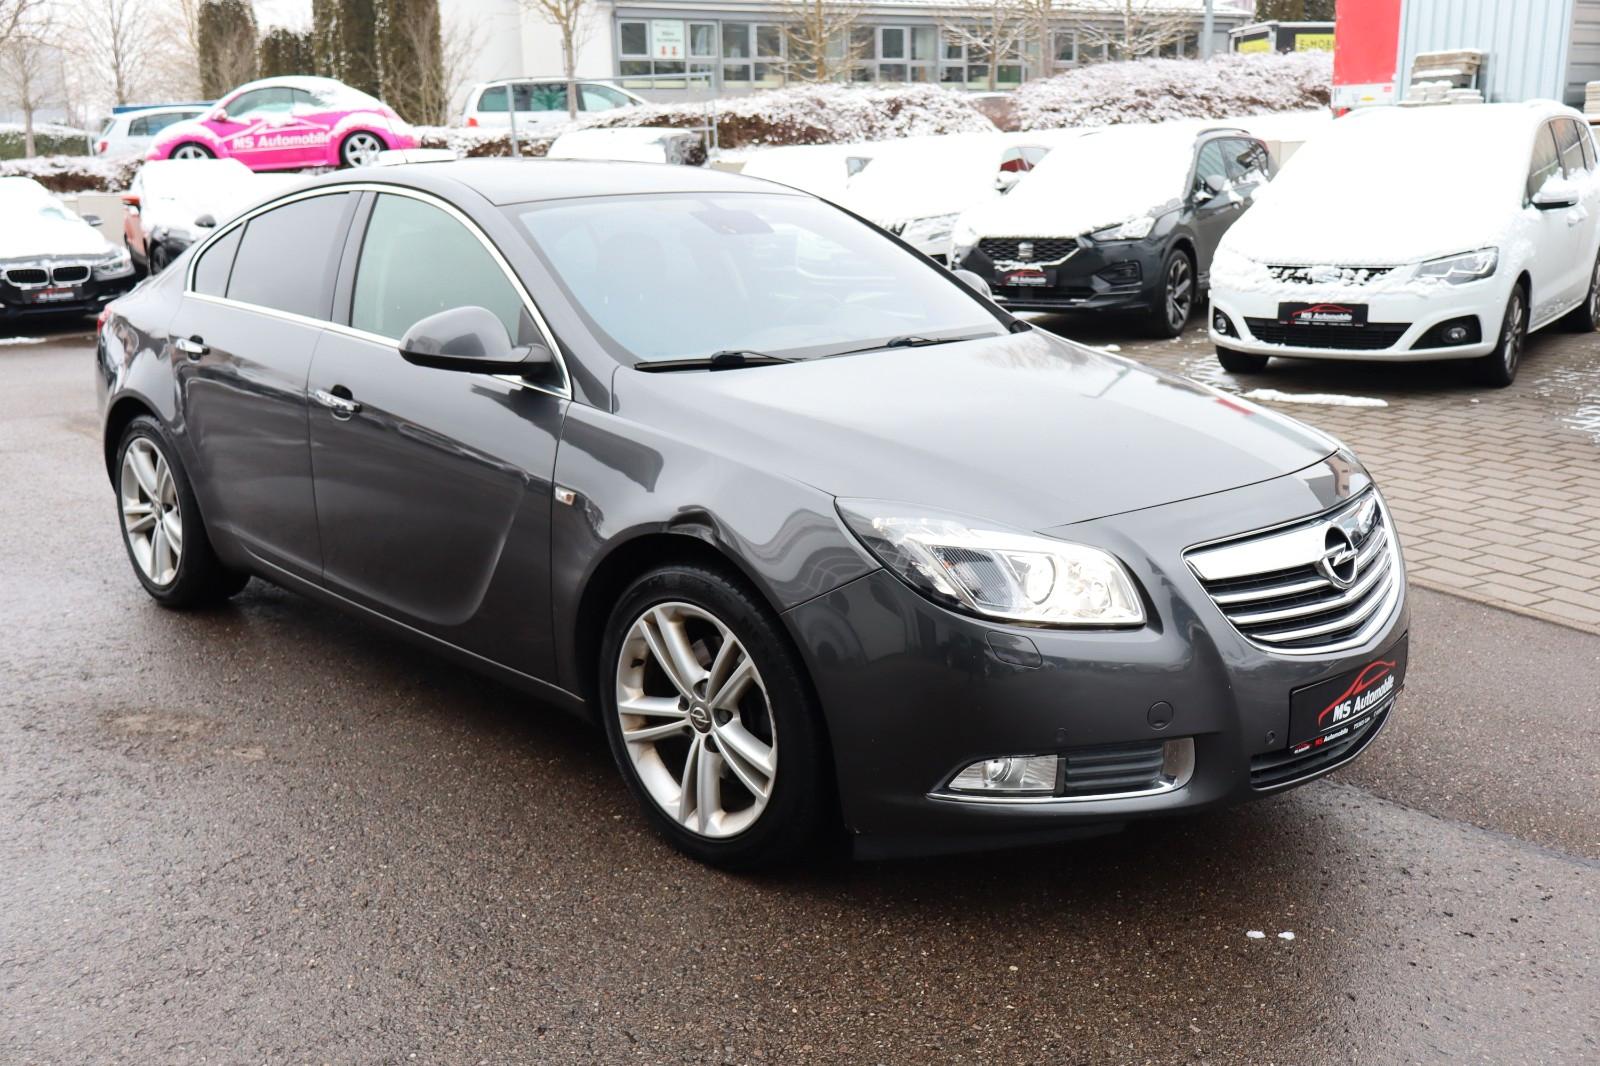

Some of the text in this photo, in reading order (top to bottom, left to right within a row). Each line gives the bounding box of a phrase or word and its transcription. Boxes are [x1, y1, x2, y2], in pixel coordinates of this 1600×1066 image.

[233, 136, 255, 149] MS
[1300, 311, 1352, 320] MS Automobile
[1333, 700, 1352, 722] MS
[1353, 674, 1395, 714] Automobile
[1324, 728, 1349, 742] Automobile
